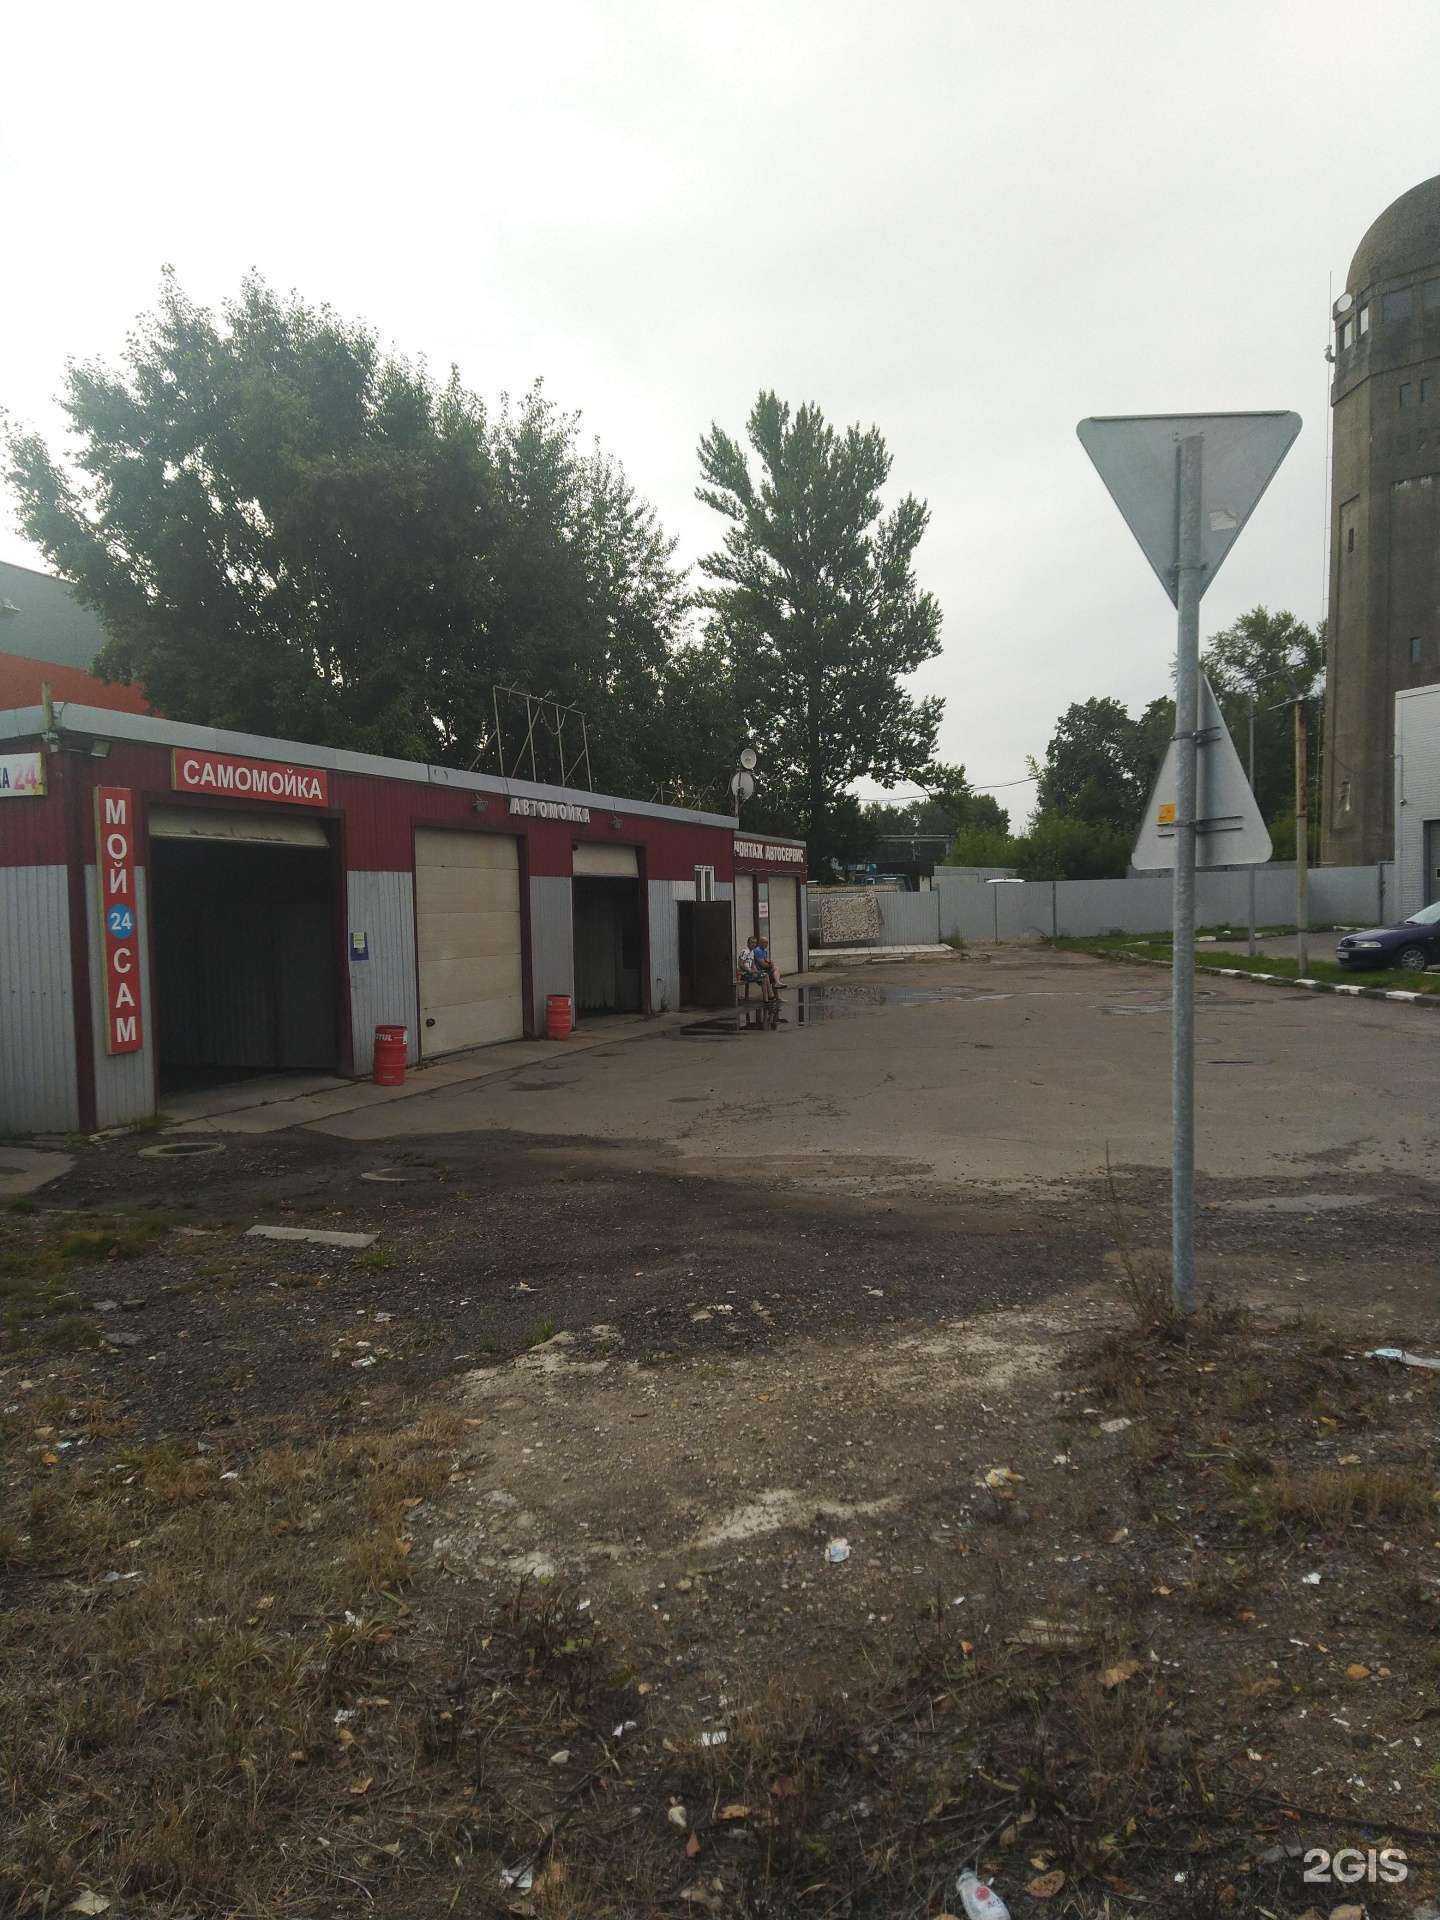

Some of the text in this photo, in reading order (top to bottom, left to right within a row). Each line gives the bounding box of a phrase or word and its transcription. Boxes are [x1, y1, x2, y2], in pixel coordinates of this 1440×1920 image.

[183, 759, 323, 800] САМОМОЙКА
[509, 798, 591, 824] АВТОМОЙКА
[105, 798, 128, 894] МОЙ
[764, 845, 804, 864] АВТОСЕРВИС
[110, 911, 132, 931] 24
[113, 946, 137, 1043] САМ
